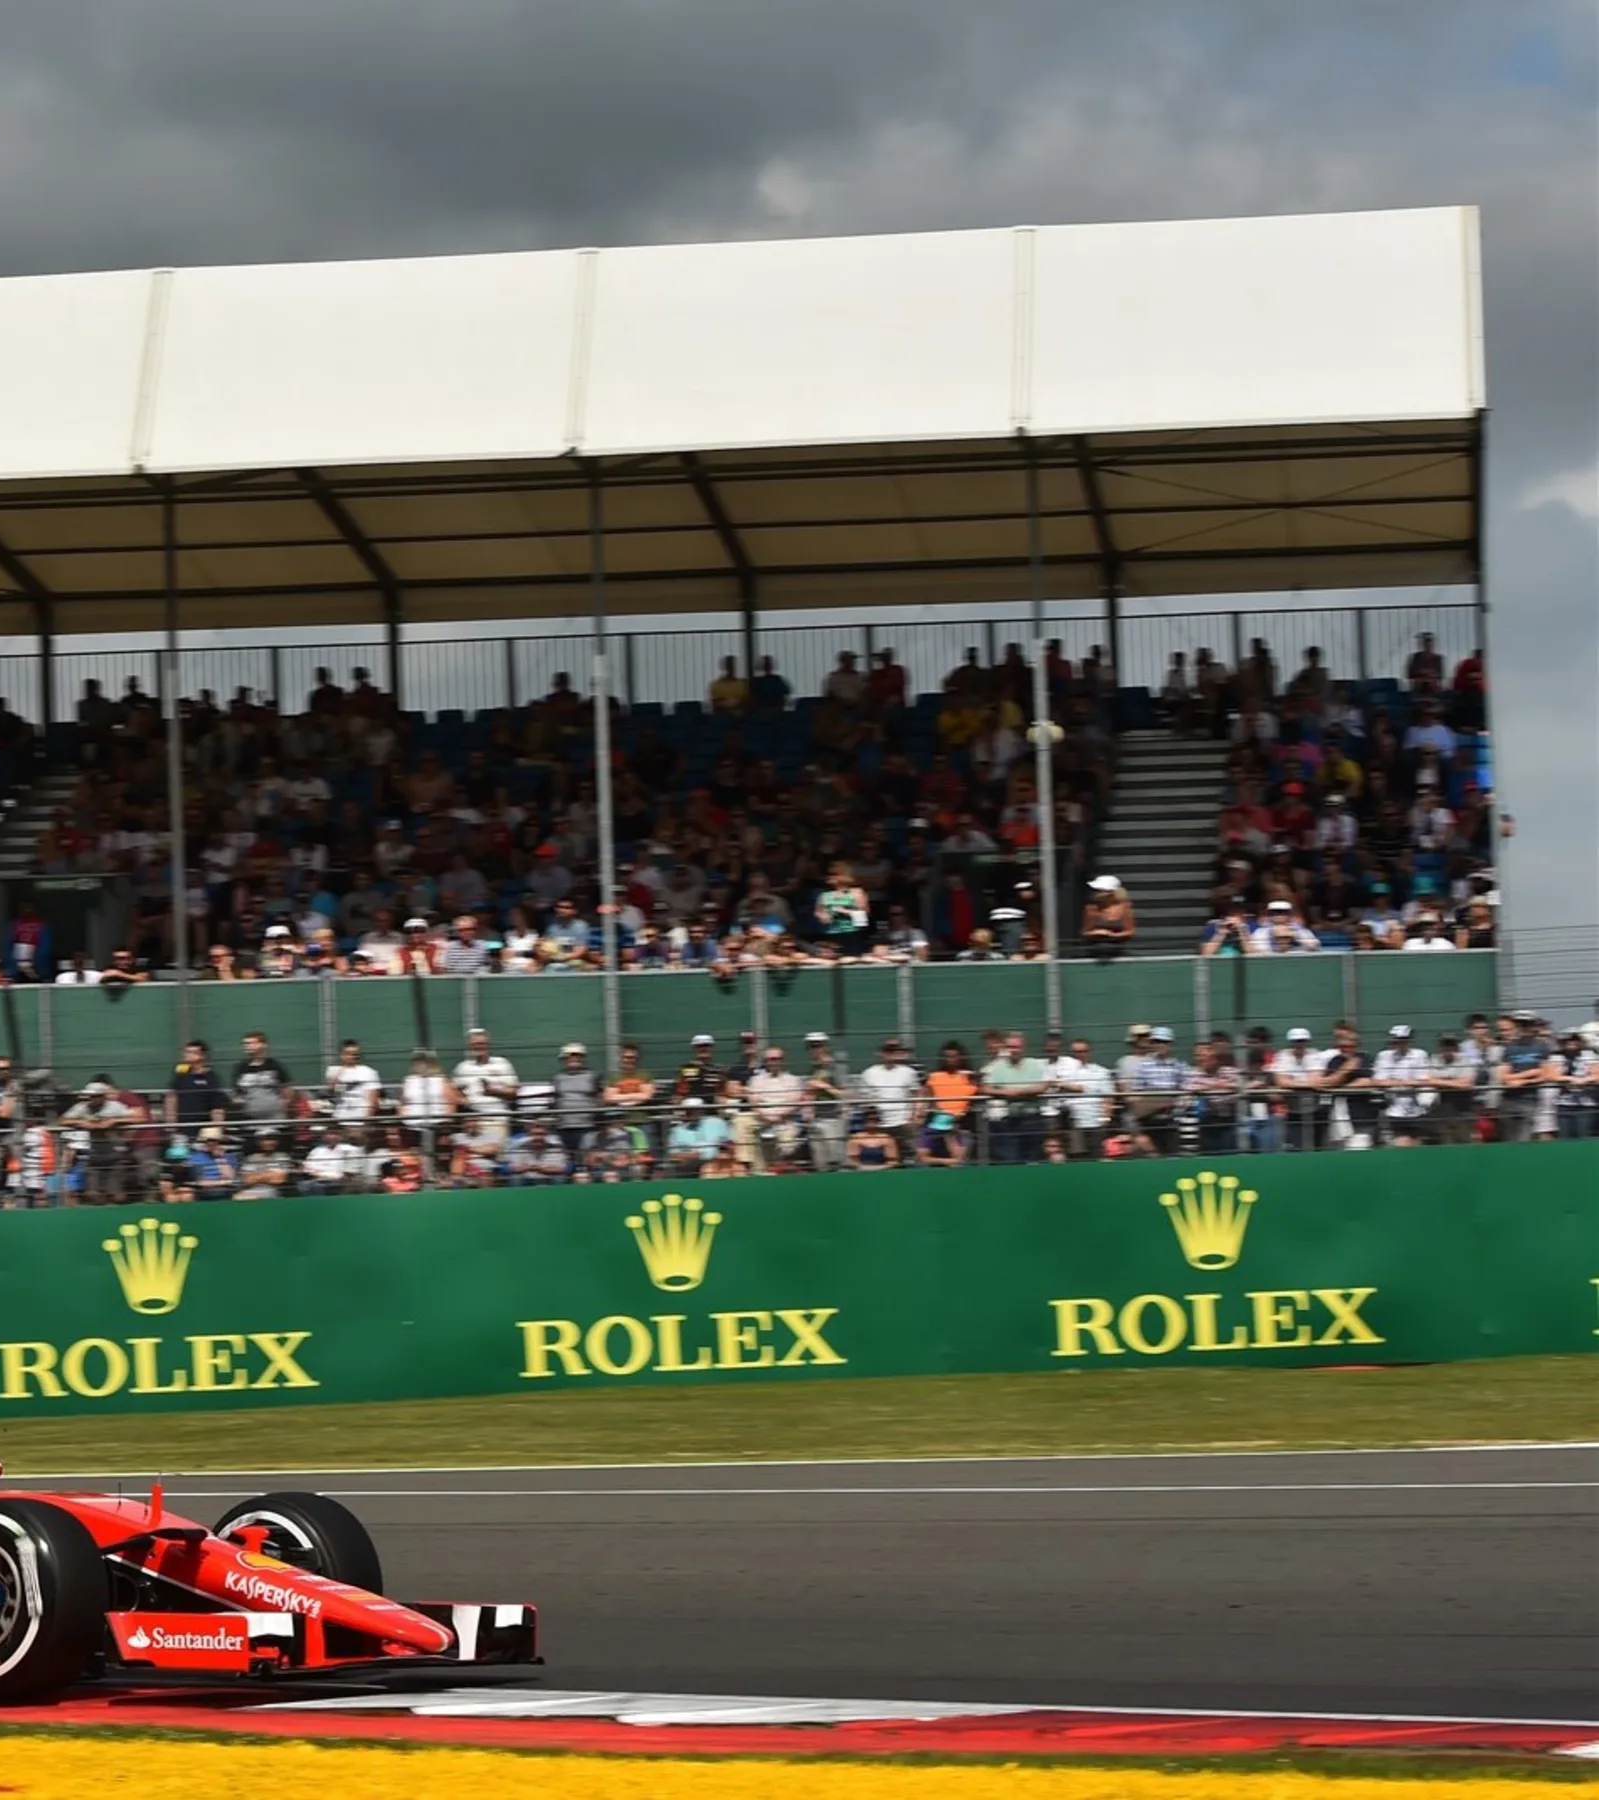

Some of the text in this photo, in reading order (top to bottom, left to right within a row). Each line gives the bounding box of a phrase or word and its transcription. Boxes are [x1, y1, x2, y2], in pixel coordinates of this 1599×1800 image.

[516, 1308, 848, 1378] ROLEX
[1049, 1287, 1386, 1357] ROLEX
[225, 1571, 313, 1614] KASPERSKY
[151, 1627, 244, 1652] Santander
